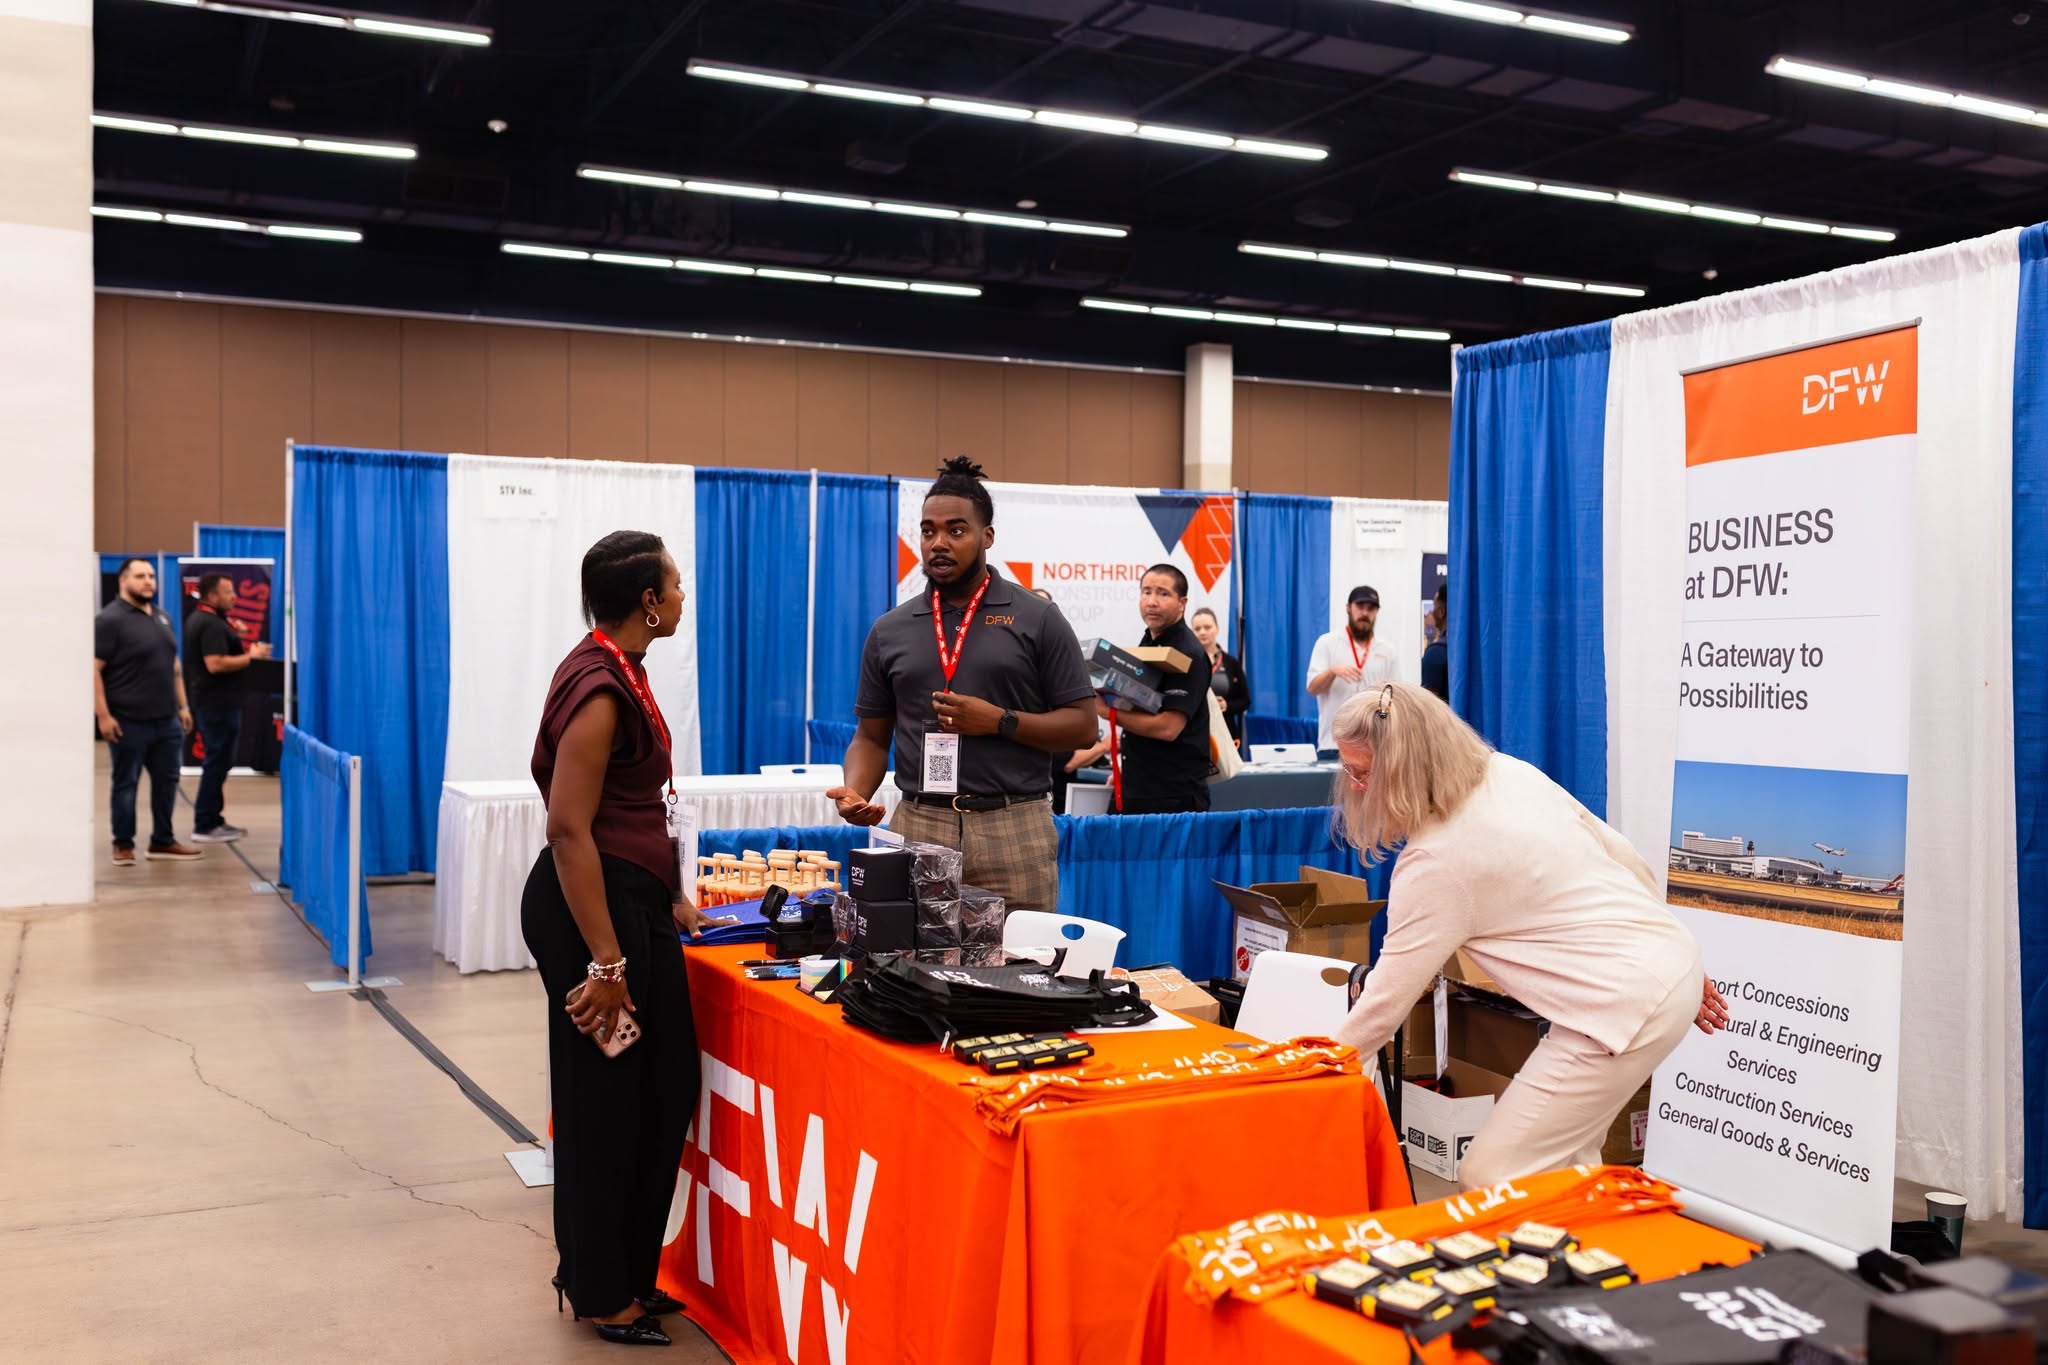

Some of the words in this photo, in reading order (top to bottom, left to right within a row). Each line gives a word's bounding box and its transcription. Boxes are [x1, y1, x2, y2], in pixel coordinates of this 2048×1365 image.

[1802, 360, 1889, 415] DFW
[500, 486, 516, 496] STV
[1688, 508, 1834, 554] BUSINESS
[1043, 563, 1147, 581] NORTHRID
[1685, 571, 1705, 600] at
[1711, 562, 1789, 598] DFW:
[985, 615, 1015, 625] DFW
[1681, 643, 1692, 668] A
[1697, 640, 1796, 674] Gateway
[1800, 642, 1823, 668] to
[1679, 681, 1808, 711] Possibilities
[1743, 981, 1850, 1023] Concessions
[1759, 1022, 1773, 1042] &
[1776, 1026, 1882, 1072] Engineering
[1727, 1050, 1797, 1085] Services
[1675, 1071, 1776, 1117] Construction
[1779, 1100, 1854, 1139] Services
[1658, 1102, 1717, 1136] General
[1720, 1122, 1774, 1153] Goods
[1778, 1137, 1791, 1158] &
[1795, 1142, 1870, 1184] Services
